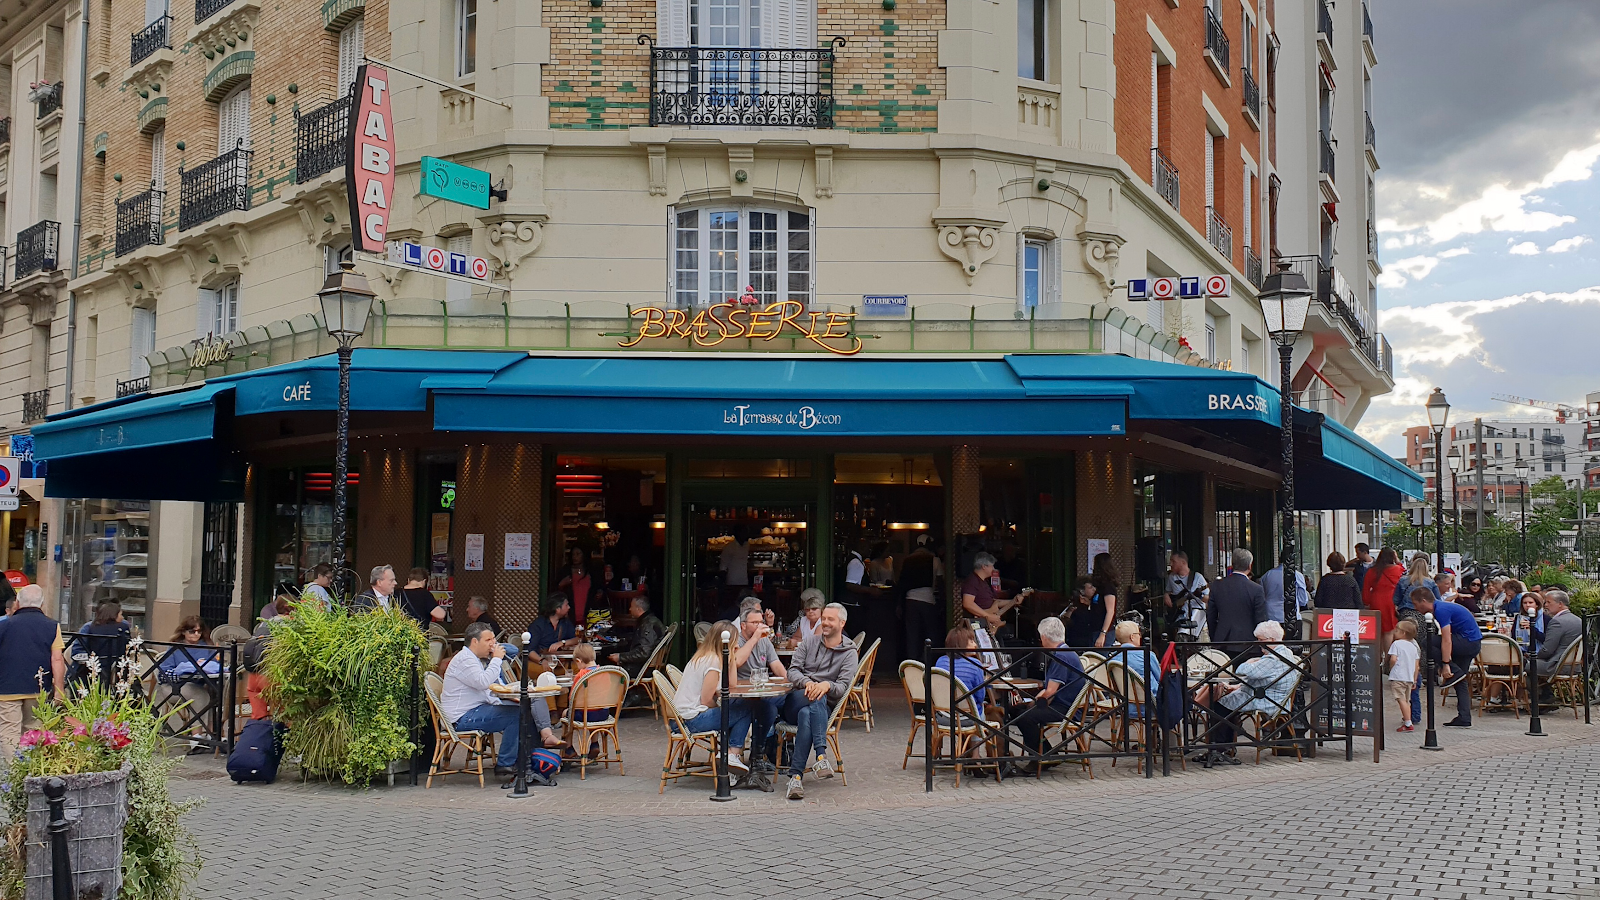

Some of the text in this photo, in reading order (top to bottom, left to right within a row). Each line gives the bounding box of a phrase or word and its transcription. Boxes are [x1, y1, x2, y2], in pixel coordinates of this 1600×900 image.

[362, 77, 391, 242] TABAC
[404, 244, 488, 278] LOTO
[1128, 276, 1226, 298] LOTO
[618, 300, 863, 355] BRASSERIE
[283, 381, 312, 401] CAFÉ
[734, 404, 783, 426] Terrasse
[786, 411, 797, 425] de
[799, 406, 841, 429] Bécon
